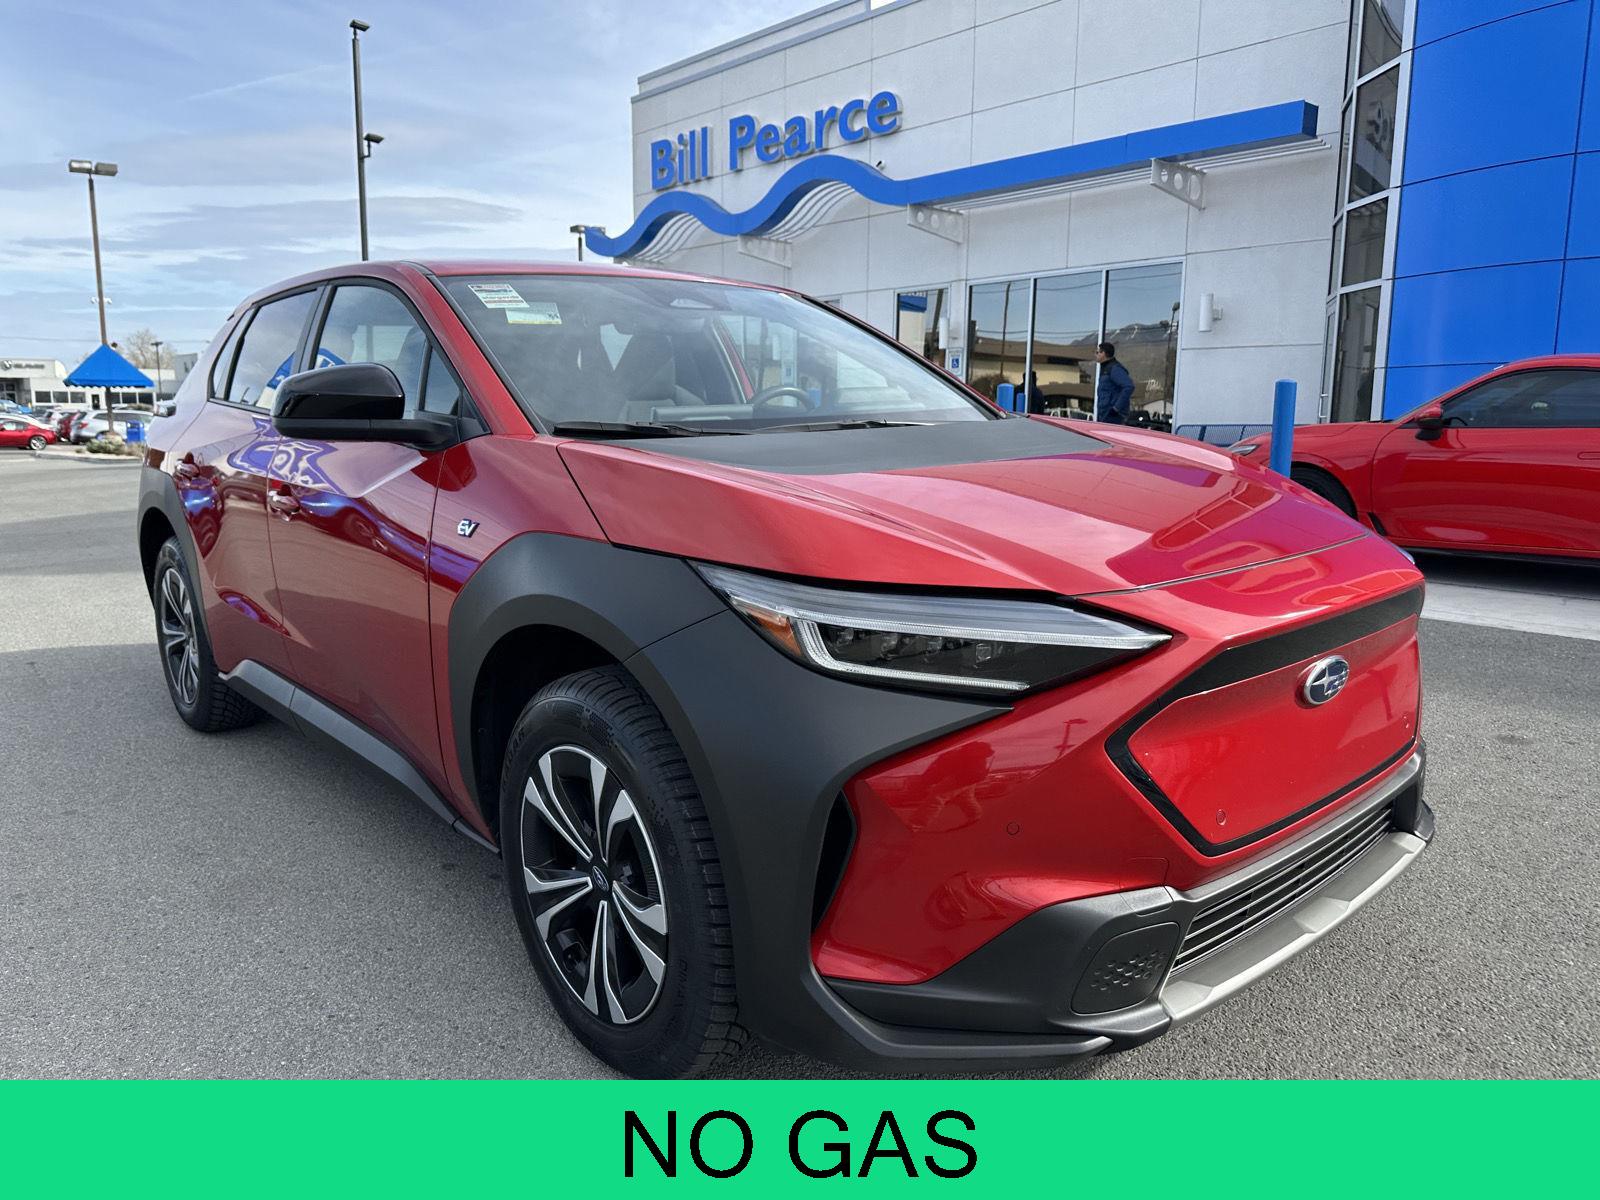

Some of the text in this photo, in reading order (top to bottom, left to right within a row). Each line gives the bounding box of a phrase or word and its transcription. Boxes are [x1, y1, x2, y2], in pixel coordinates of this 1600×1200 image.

[651, 91, 903, 190] Bill Pearce
[457, 519, 479, 537] EV
